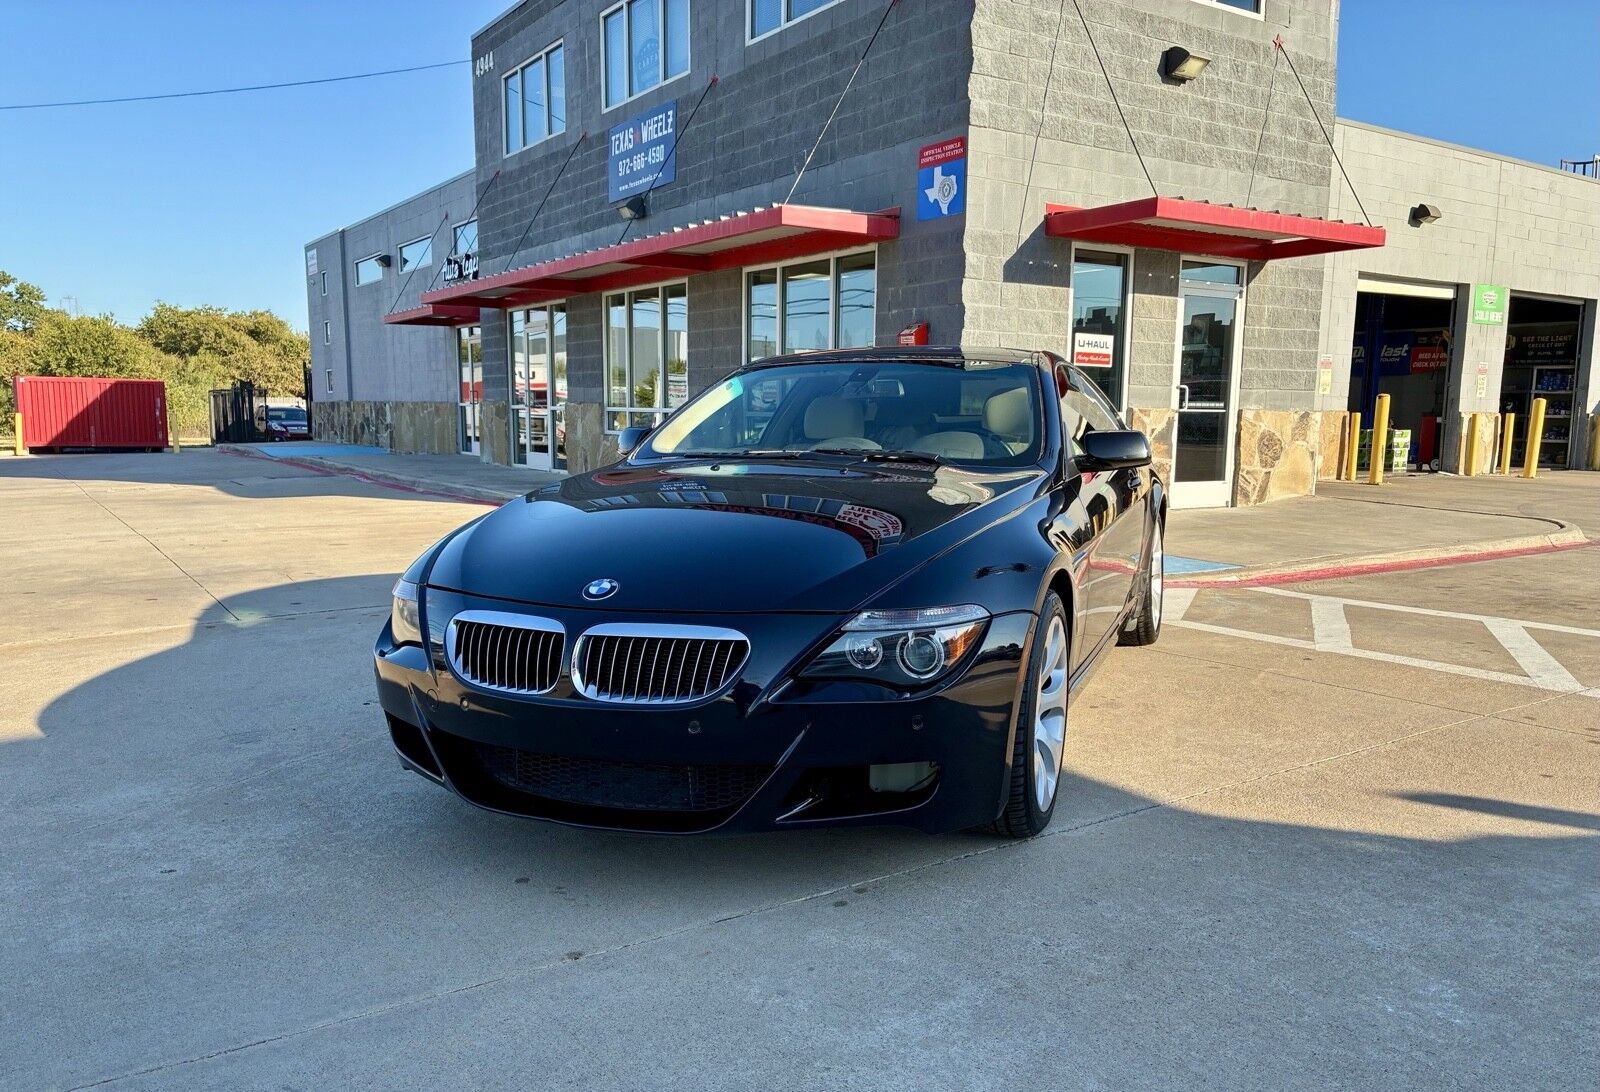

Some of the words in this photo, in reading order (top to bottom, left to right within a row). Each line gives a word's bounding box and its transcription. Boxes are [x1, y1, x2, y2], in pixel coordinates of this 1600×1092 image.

[475, 50, 494, 77] 4944
[611, 127, 634, 156] TEXAS
[641, 110, 673, 144] WHEELZ
[920, 153, 945, 164] INSPECTION
[945, 148, 964, 158] STATION
[923, 148, 942, 157] OFFICIAL
[942, 142, 962, 151] VEHICLE
[618, 144, 665, 177] 972-666-4590
[1078, 339, 1110, 349] U-HAUL
